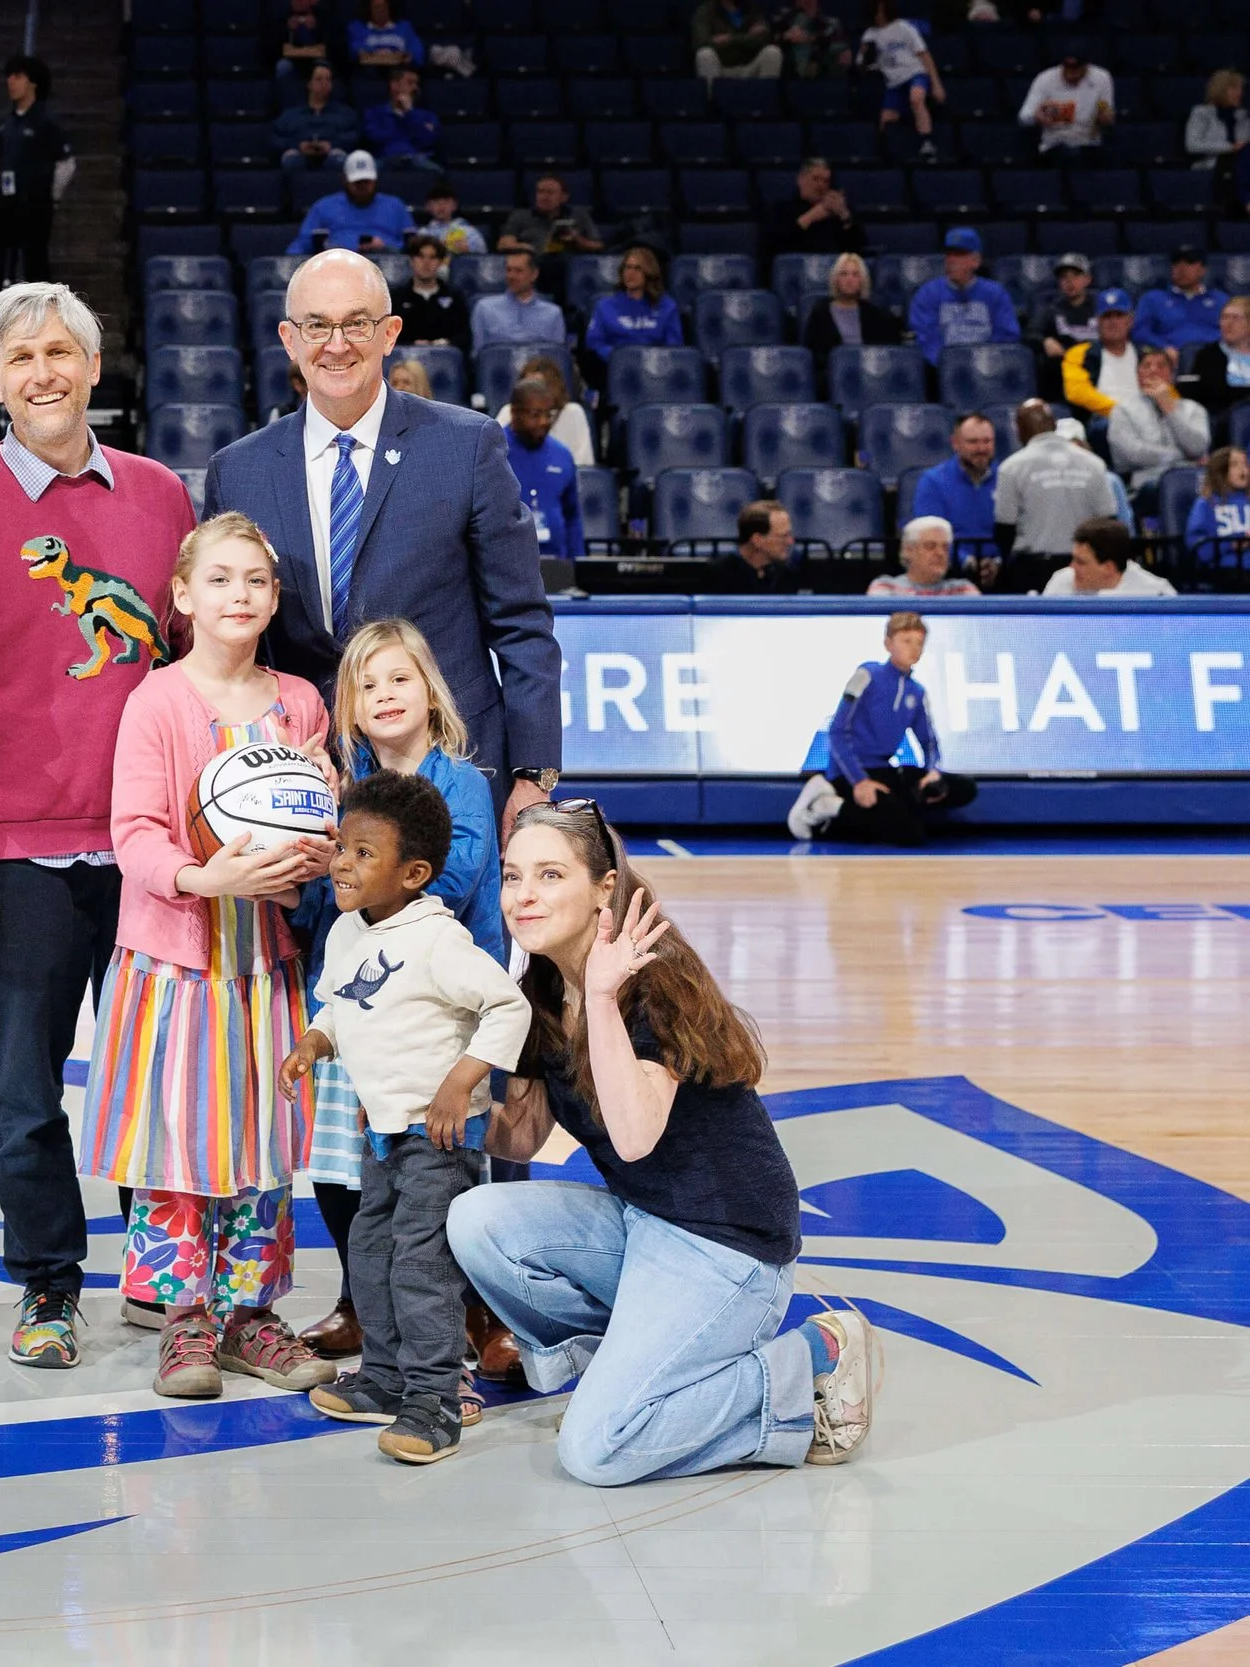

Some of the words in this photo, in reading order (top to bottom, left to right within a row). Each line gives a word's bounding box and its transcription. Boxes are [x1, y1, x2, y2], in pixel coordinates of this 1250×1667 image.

[561, 652, 713, 732] RE
[272, 789, 309, 807] SAINT
[310, 791, 333, 814] LOUIS
